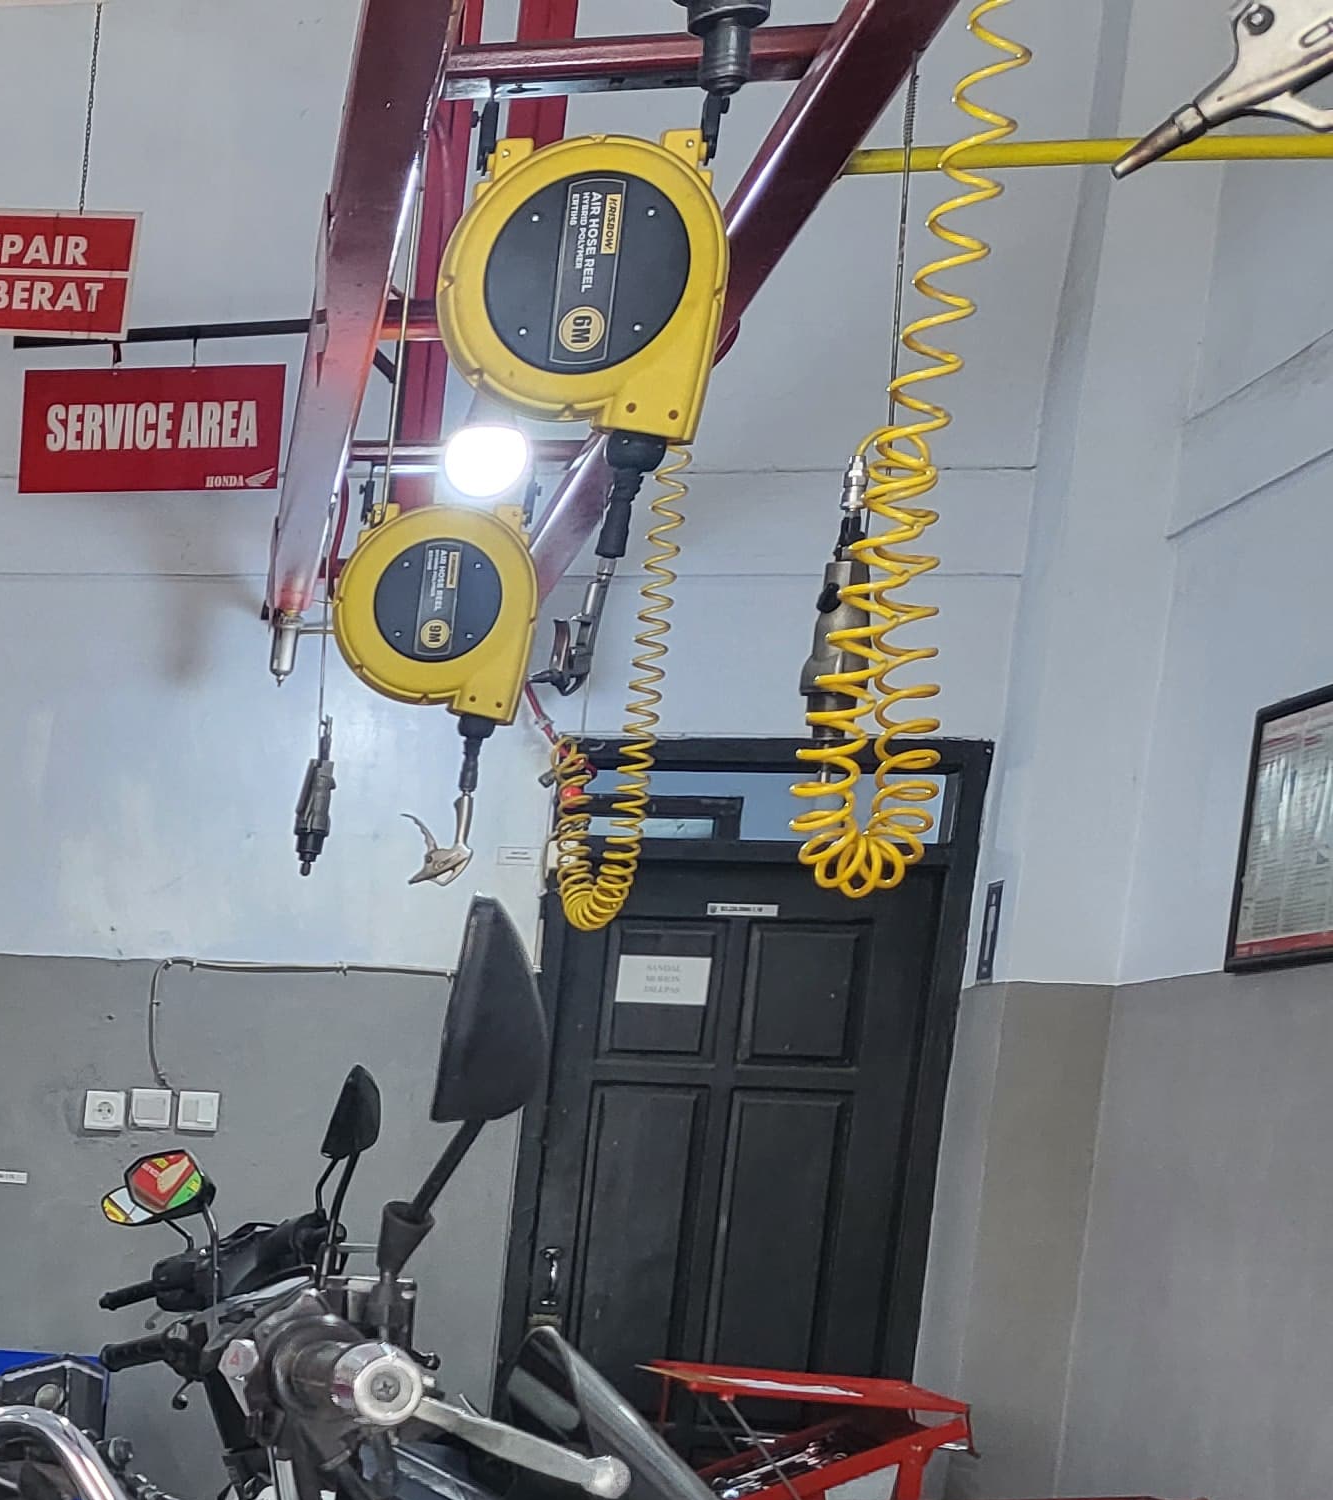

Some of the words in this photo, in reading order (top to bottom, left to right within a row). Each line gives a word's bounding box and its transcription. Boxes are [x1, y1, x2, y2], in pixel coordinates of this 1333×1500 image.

[590, 192, 602, 216] AIR
[586, 217, 601, 256] HOSE
[604, 197, 619, 251] KRISBOW
[581, 259, 596, 293] REEL
[571, 315, 592, 343] 6M
[45, 402, 175, 451] SERVICE
[178, 400, 258, 448] AREA
[205, 475, 245, 488] HONDA
[429, 625, 442, 643] 9M
